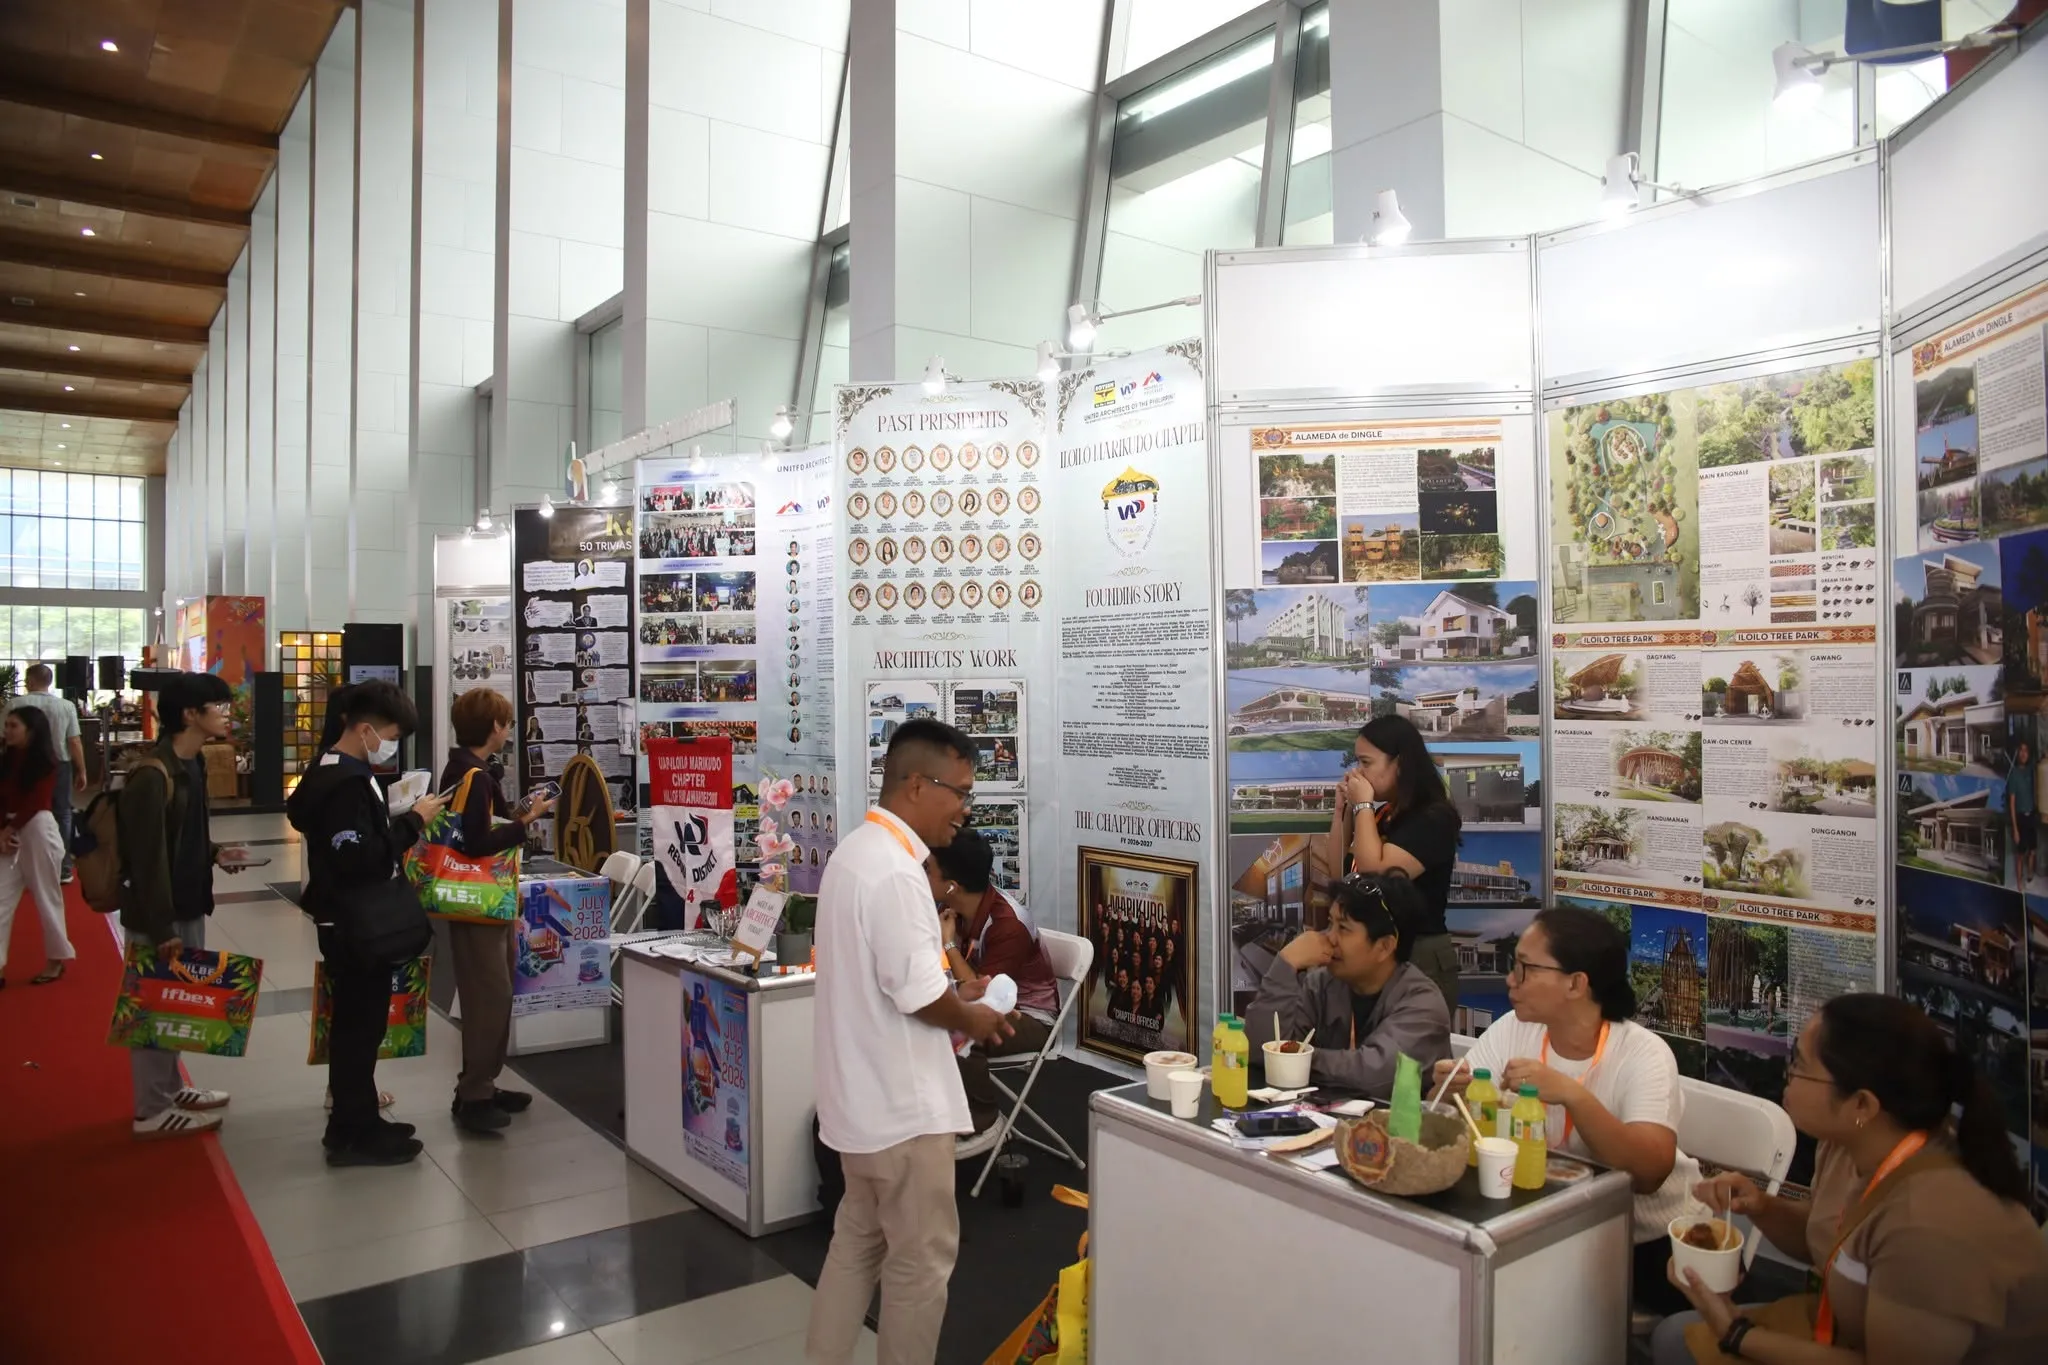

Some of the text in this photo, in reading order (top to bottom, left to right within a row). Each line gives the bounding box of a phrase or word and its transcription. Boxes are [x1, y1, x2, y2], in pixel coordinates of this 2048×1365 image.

[1943, 331, 1975, 352] ALAMEDA
[1976, 327, 1985, 336] de
[1985, 312, 2013, 332] DINGLE
[877, 410, 1008, 432] PAST PRESIDENTS
[1295, 432, 1337, 441] ALAMEDA
[1339, 432, 1349, 440] de
[1351, 430, 1383, 440] DINGLE
[1060, 446, 1091, 469] ILOILO
[1094, 432, 1152, 462] MARIKUDO
[777, 464, 804, 473] UNITED
[1699, 469, 1749, 480] MAIN RATIONALE
[580, 540, 632, 551] 50 TRIVIAS
[1086, 581, 1183, 608] FOUNDING STORY
[1584, 634, 1654, 644] ILOILO TREE PARK
[1738, 631, 1819, 641] ILOILO TREE PARK
[873, 649, 1018, 669] ARCHITECTS' WORK
[689, 756, 722, 771] MARIKUDO
[672, 772, 706, 788] CHAPTER
[1499, 769, 1520, 777] Vue
[1075, 810, 1201, 843] THE CHAPTER OFFICERS
[1811, 828, 1857, 837] DUNGGANON
[1127, 838, 1153, 847] 2026-2027
[687, 889, 695, 903] 4
[1584, 883, 1654, 898] ILOILO TREE PARK
[577, 896, 605, 910] JULY
[1739, 904, 1820, 921] ILOILO TREE PARK
[574, 925, 606, 940] 2026
[1136, 1014, 1160, 1030] OFFICERS
